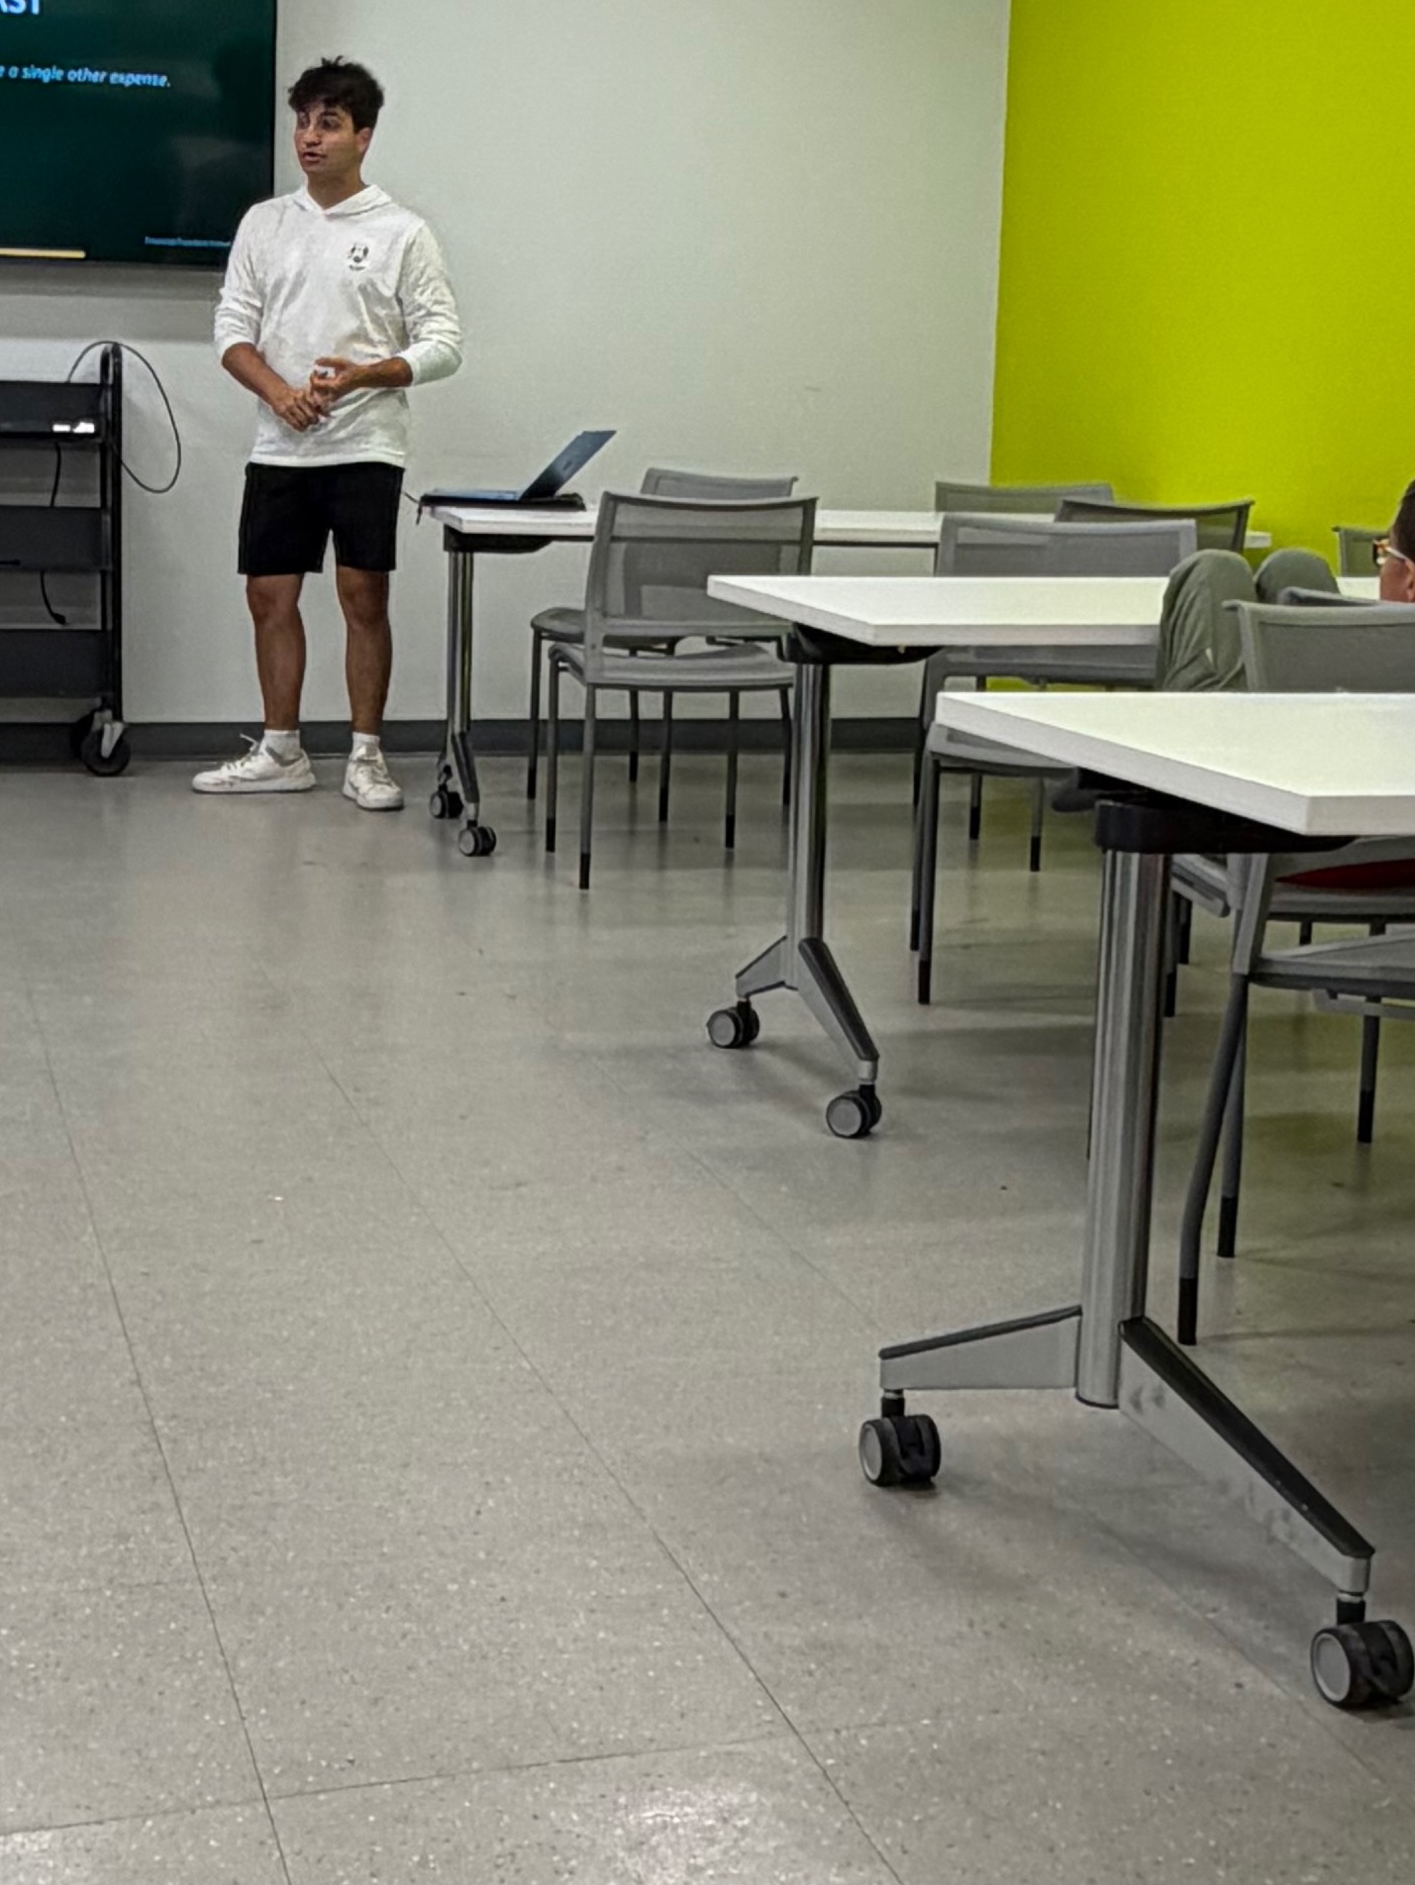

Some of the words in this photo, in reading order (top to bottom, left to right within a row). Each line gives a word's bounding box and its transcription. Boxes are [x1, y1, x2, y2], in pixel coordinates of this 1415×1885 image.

[8, 66, 19, 79] a
[21, 64, 64, 84] single
[67, 67, 107, 84] other
[109, 71, 171, 88] expense.
